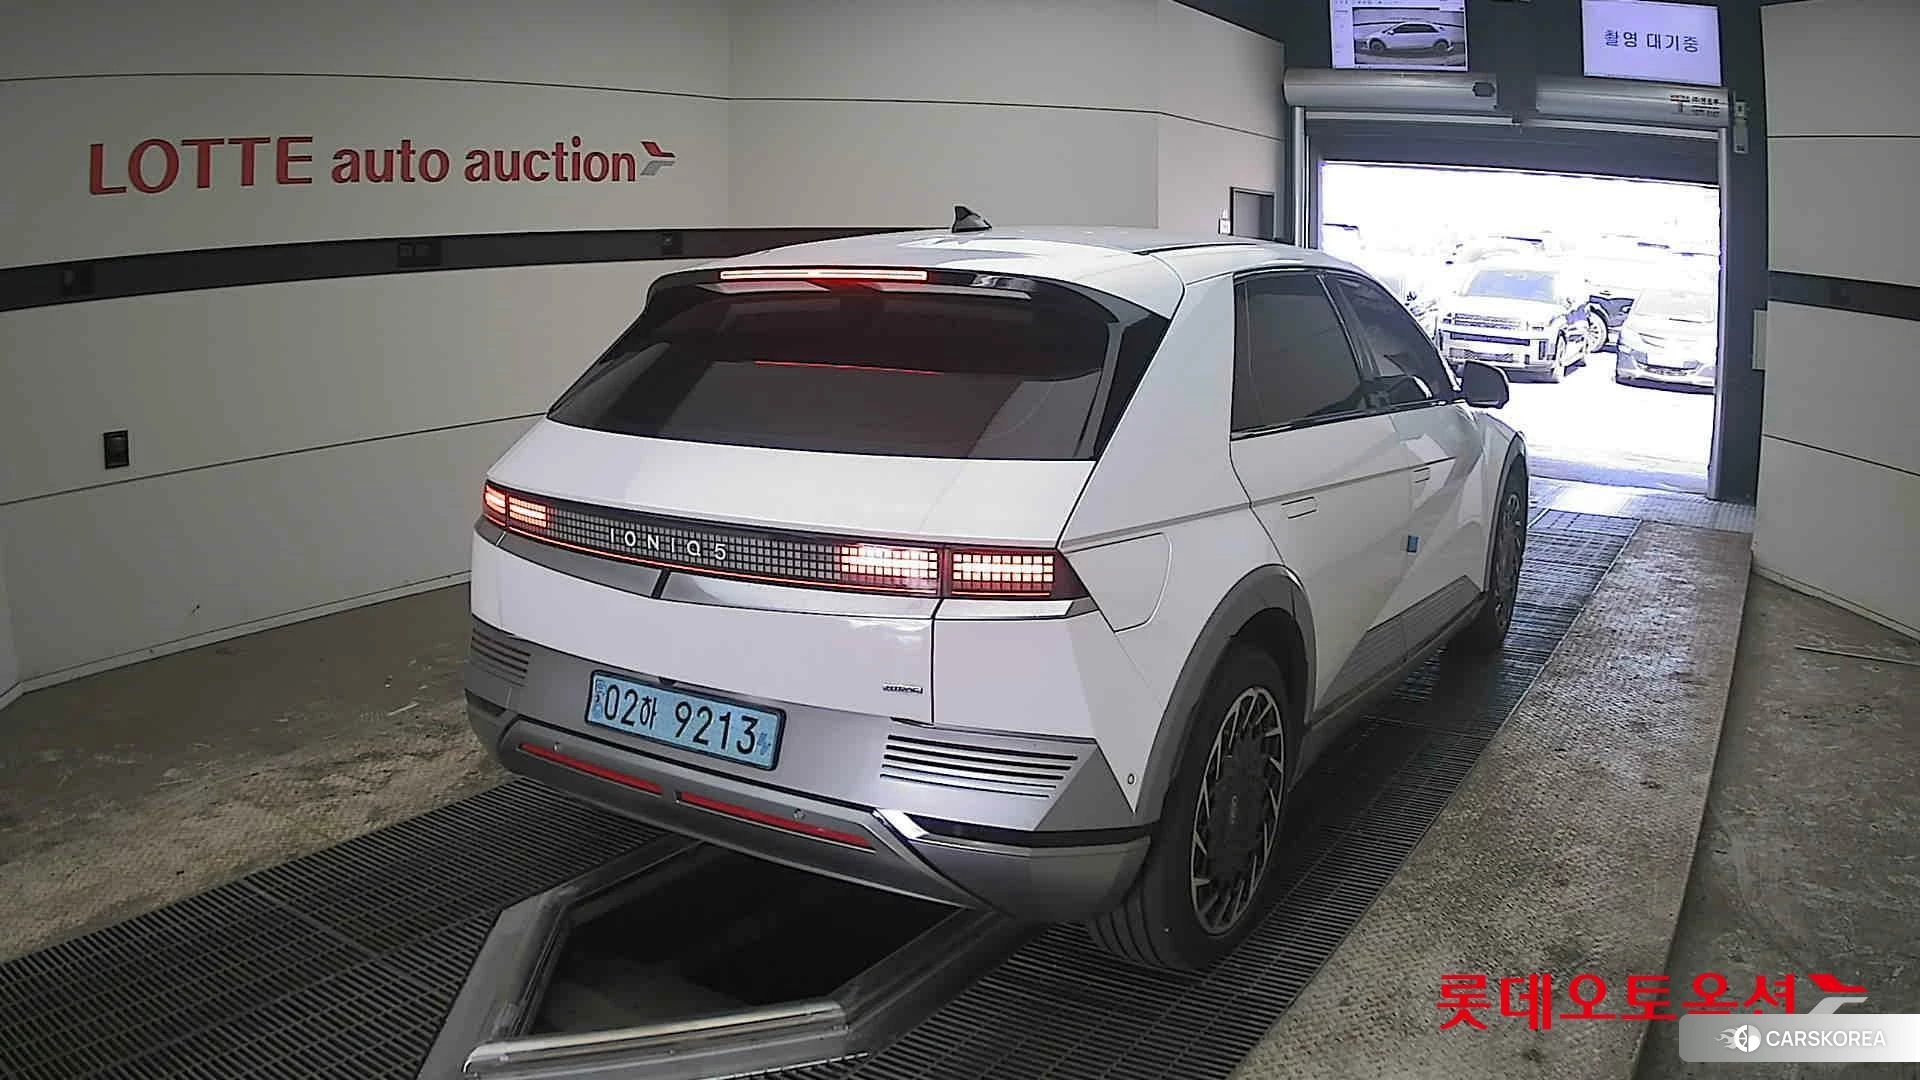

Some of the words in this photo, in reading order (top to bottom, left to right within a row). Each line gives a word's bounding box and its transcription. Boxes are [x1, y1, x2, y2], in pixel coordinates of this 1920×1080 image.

[1646, 33, 1698, 53] 대기중
[89, 135, 313, 195] LOTTE
[331, 138, 449, 183] auto
[463, 135, 636, 183] auction
[610, 527, 701, 557] IONIQ
[714, 543, 727, 560] 5
[604, 684, 657, 730] 02하
[675, 701, 759, 755] 9213
